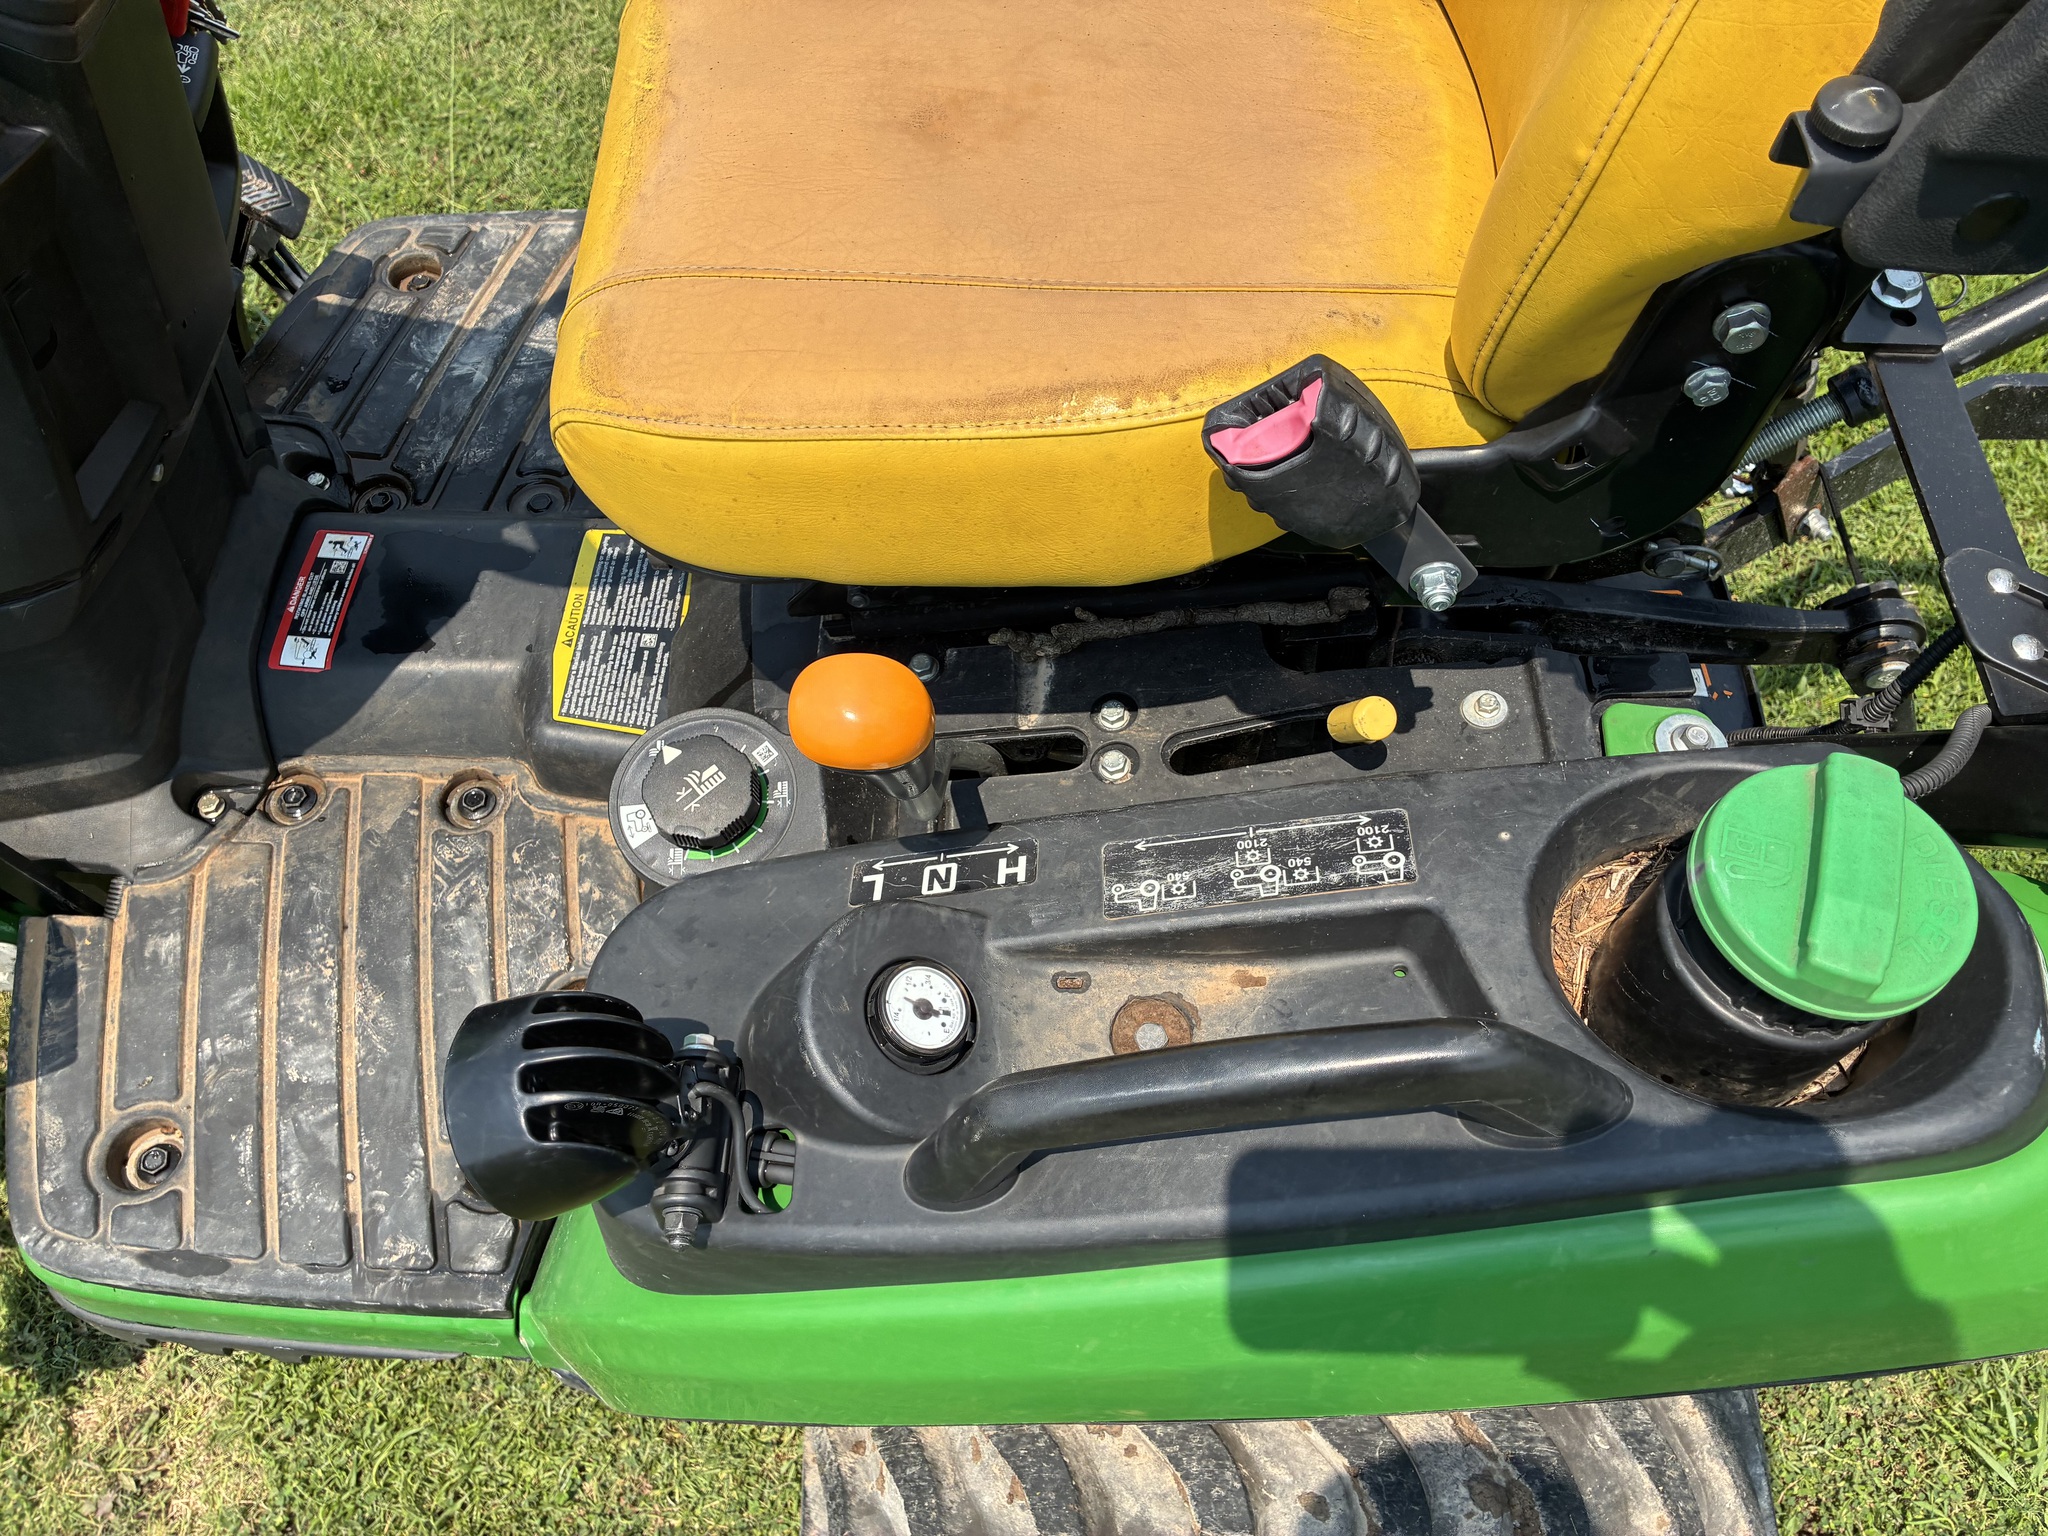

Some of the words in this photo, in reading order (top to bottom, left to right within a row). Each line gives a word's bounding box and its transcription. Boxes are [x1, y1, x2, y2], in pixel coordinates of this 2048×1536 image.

[289, 576, 306, 605] DANGER
[565, 594, 584, 637] CAUTION
[1236, 838, 1268, 849] 2100
[1357, 825, 1390, 837] 2100
[997, 856, 1027, 884] H
[1288, 857, 1312, 867] 540
[862, 874, 884, 901] L
[927, 865, 952, 893] N
[1166, 871, 1190, 882] 540
[1898, 833, 1960, 963] DIESEL
[924, 974, 932, 985] 3/4
